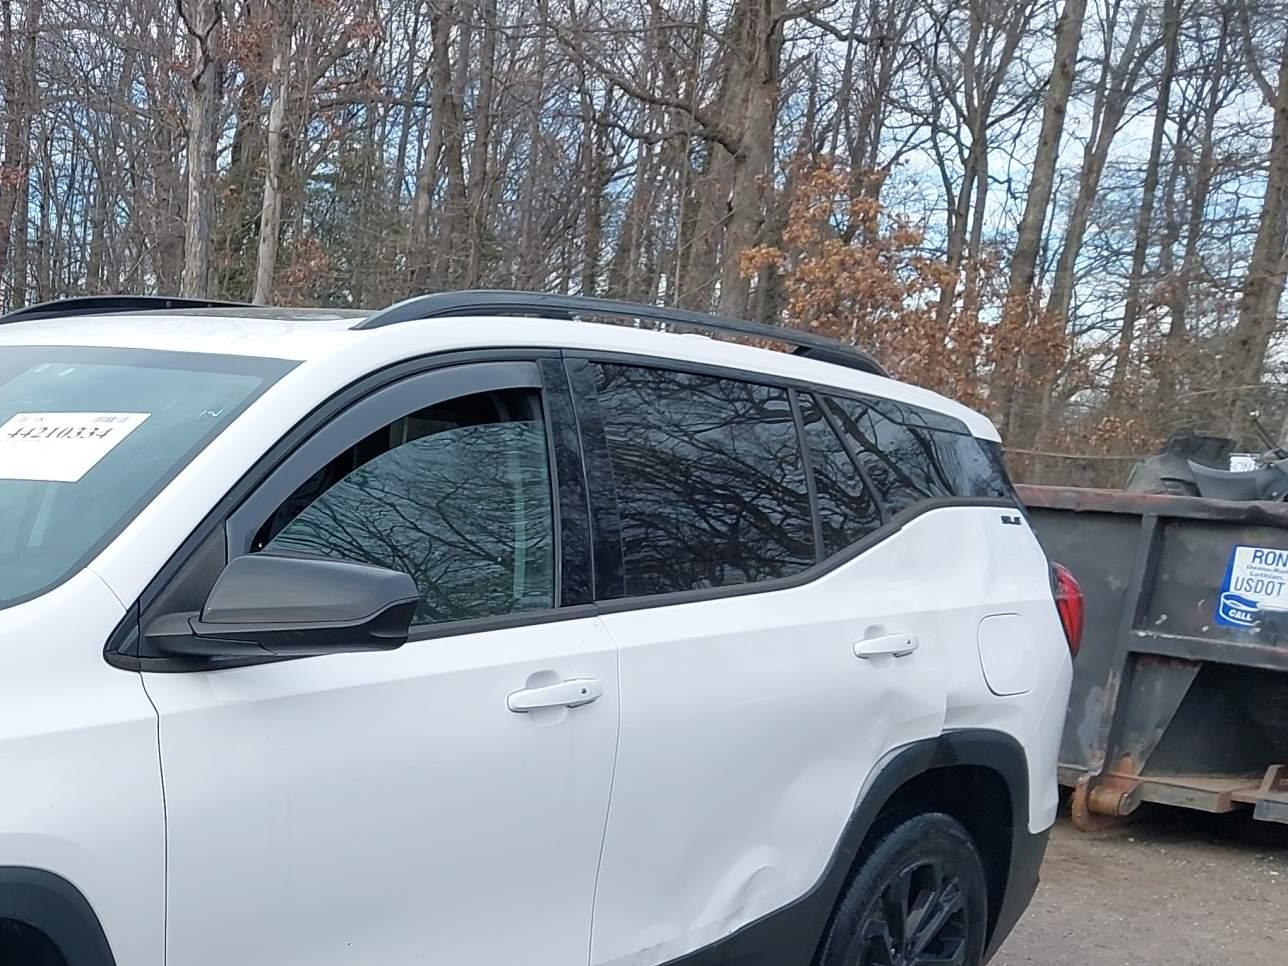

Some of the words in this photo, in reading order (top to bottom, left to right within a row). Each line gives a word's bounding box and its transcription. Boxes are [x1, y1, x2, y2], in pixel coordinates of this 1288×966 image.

[7, 426, 114, 439] 44210334
[1234, 576, 1286, 597] USDOT
[1228, 609, 1253, 621] CALL
